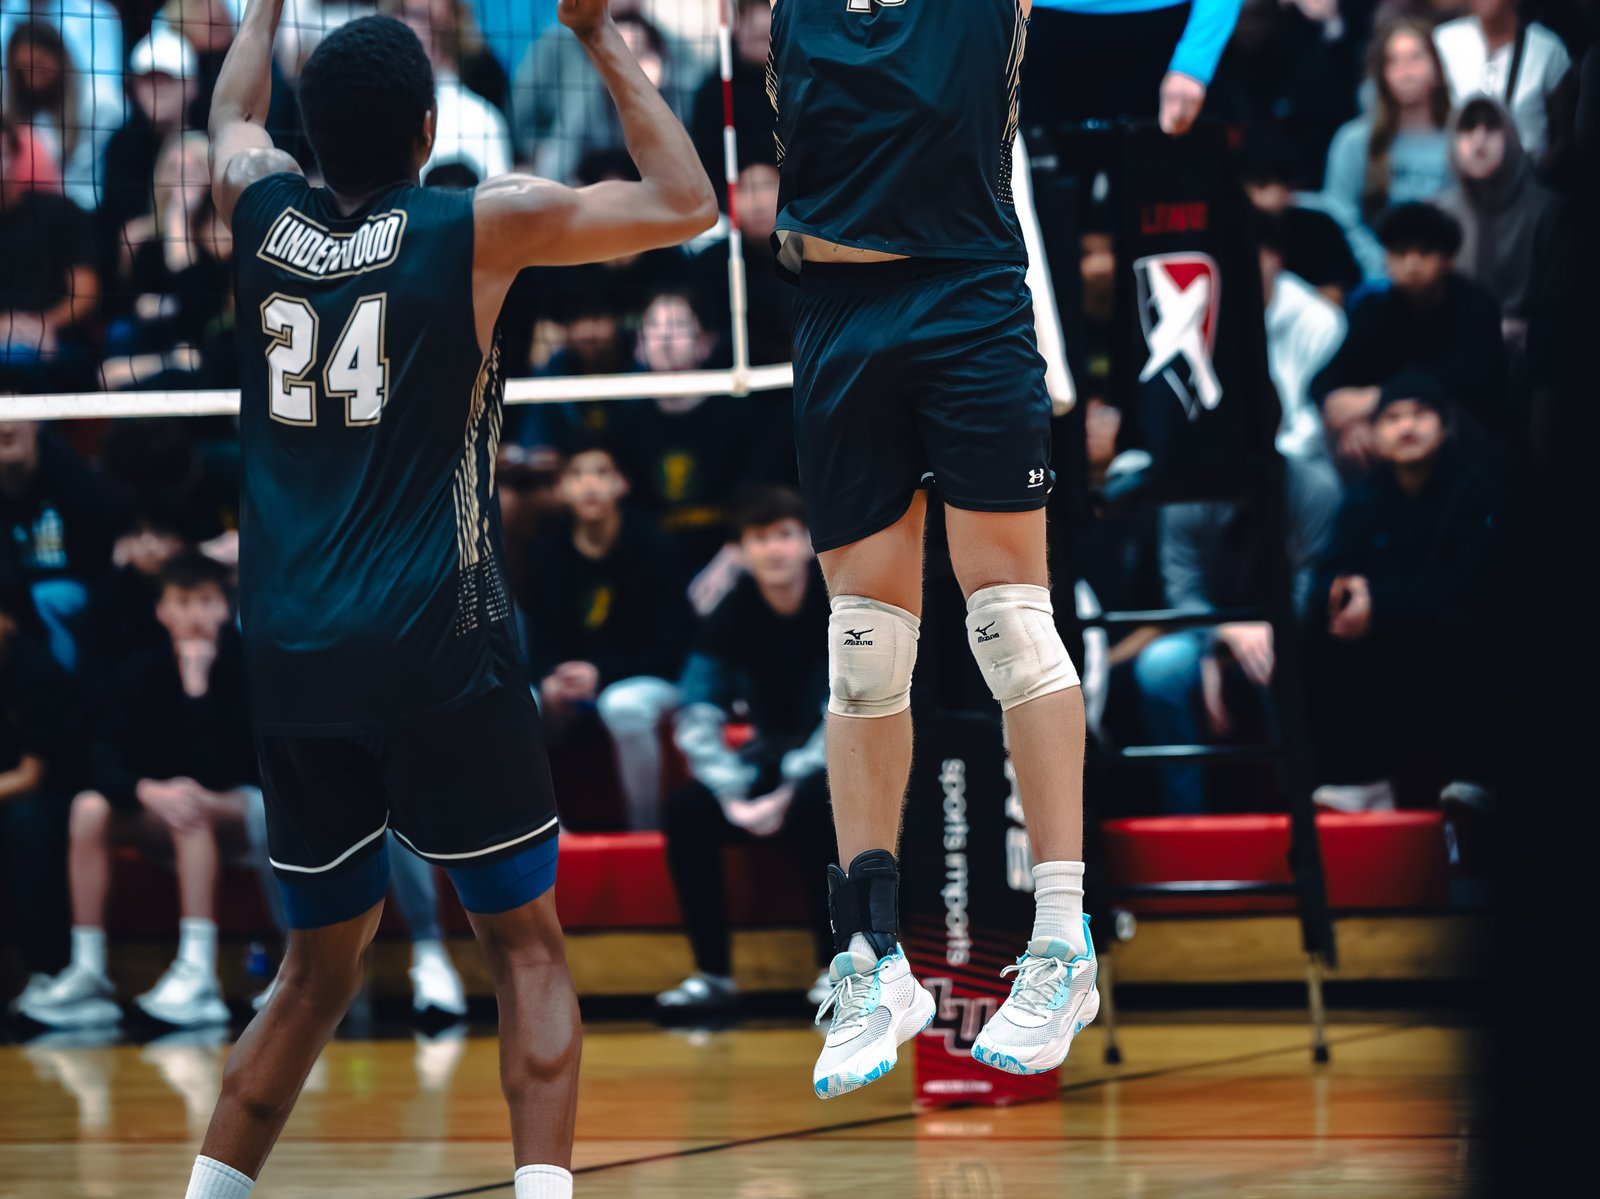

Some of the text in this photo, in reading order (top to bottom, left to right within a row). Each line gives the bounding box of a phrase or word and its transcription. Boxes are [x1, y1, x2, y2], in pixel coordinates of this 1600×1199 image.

[265, 215, 400, 275] LINDENWOOD
[260, 292, 390, 427] 24
[938, 758, 970, 851] sports
